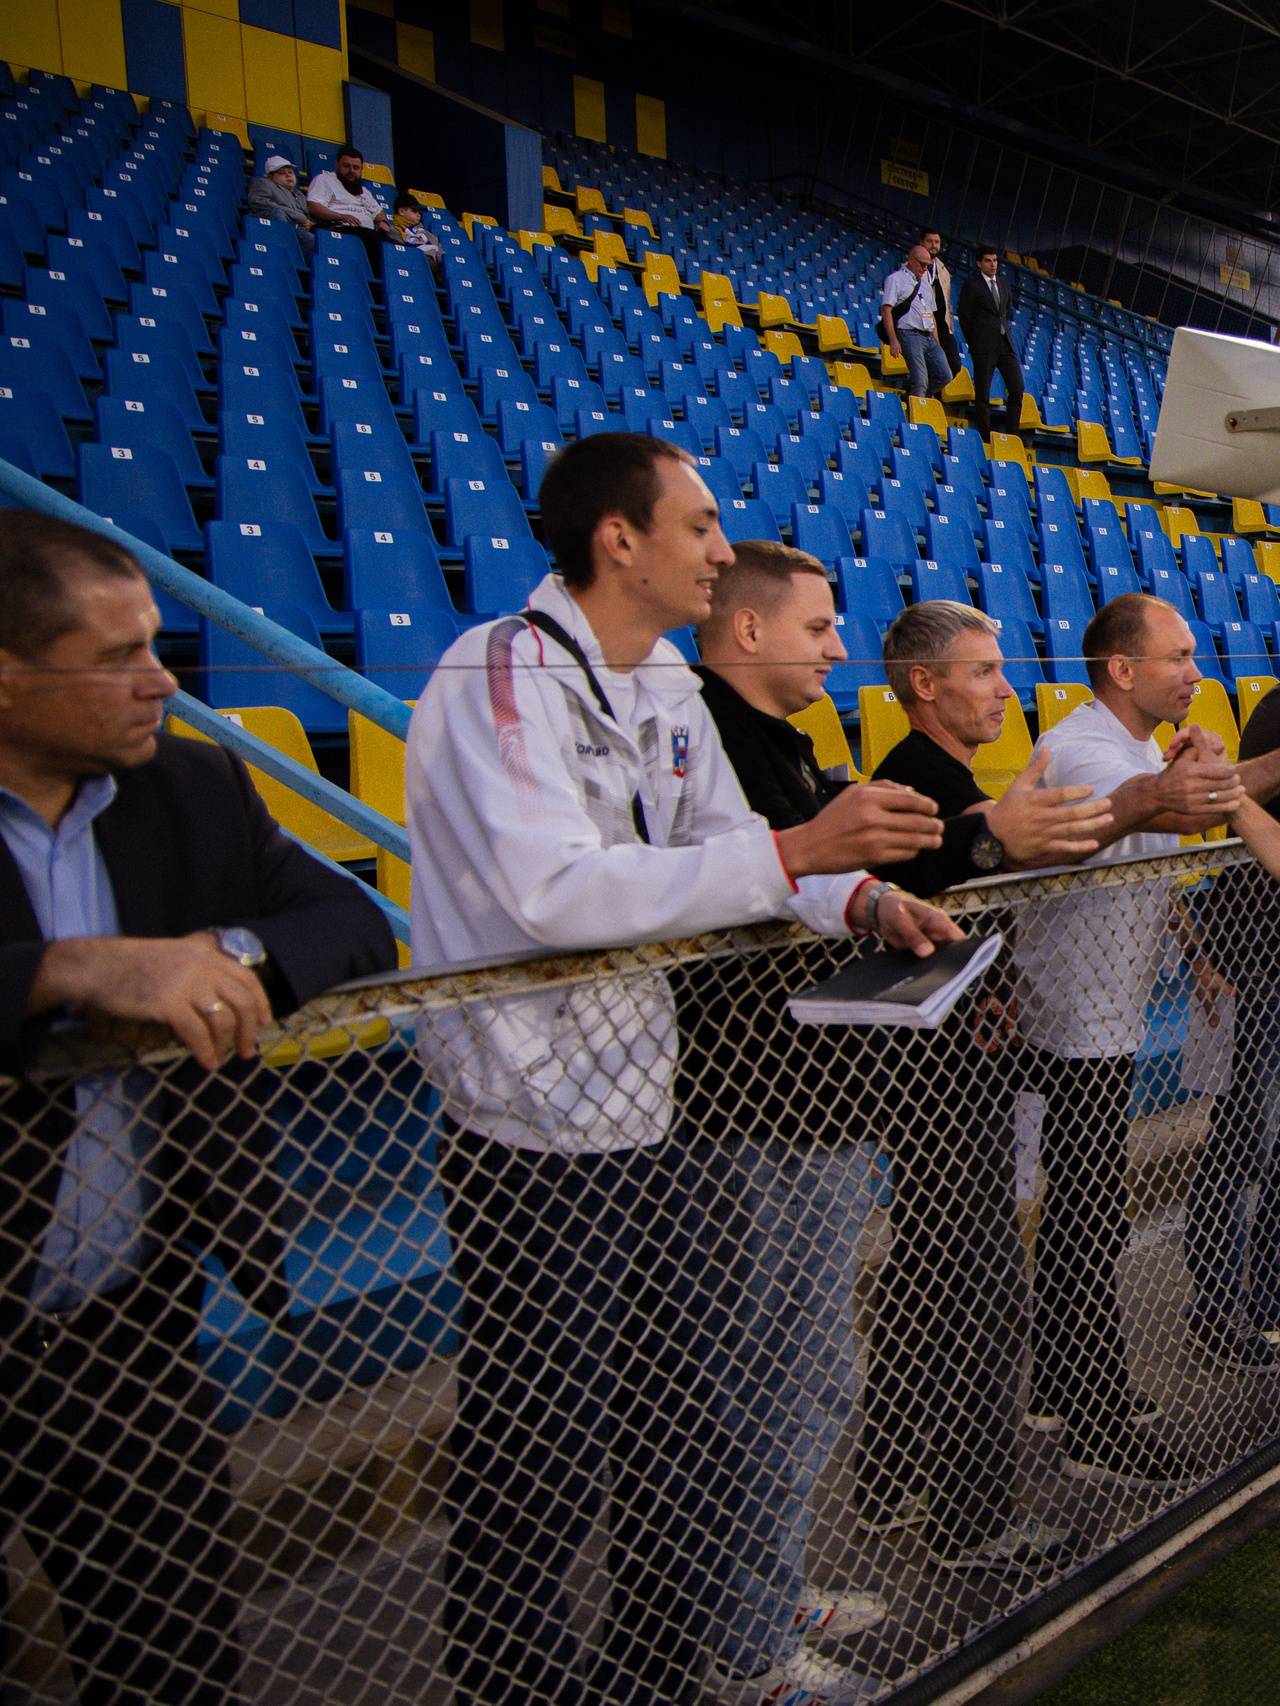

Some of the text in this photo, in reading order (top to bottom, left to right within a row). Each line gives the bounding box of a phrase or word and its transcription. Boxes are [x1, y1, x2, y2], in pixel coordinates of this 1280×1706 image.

[118, 449, 126, 458] 3
[246, 526, 254, 535] 3
[380, 534, 387, 542] 4
[496, 540, 503, 548] 5
[396, 615, 404, 624] 3
[888, 692, 894, 701] 6
[1058, 690, 1064, 699] 8
